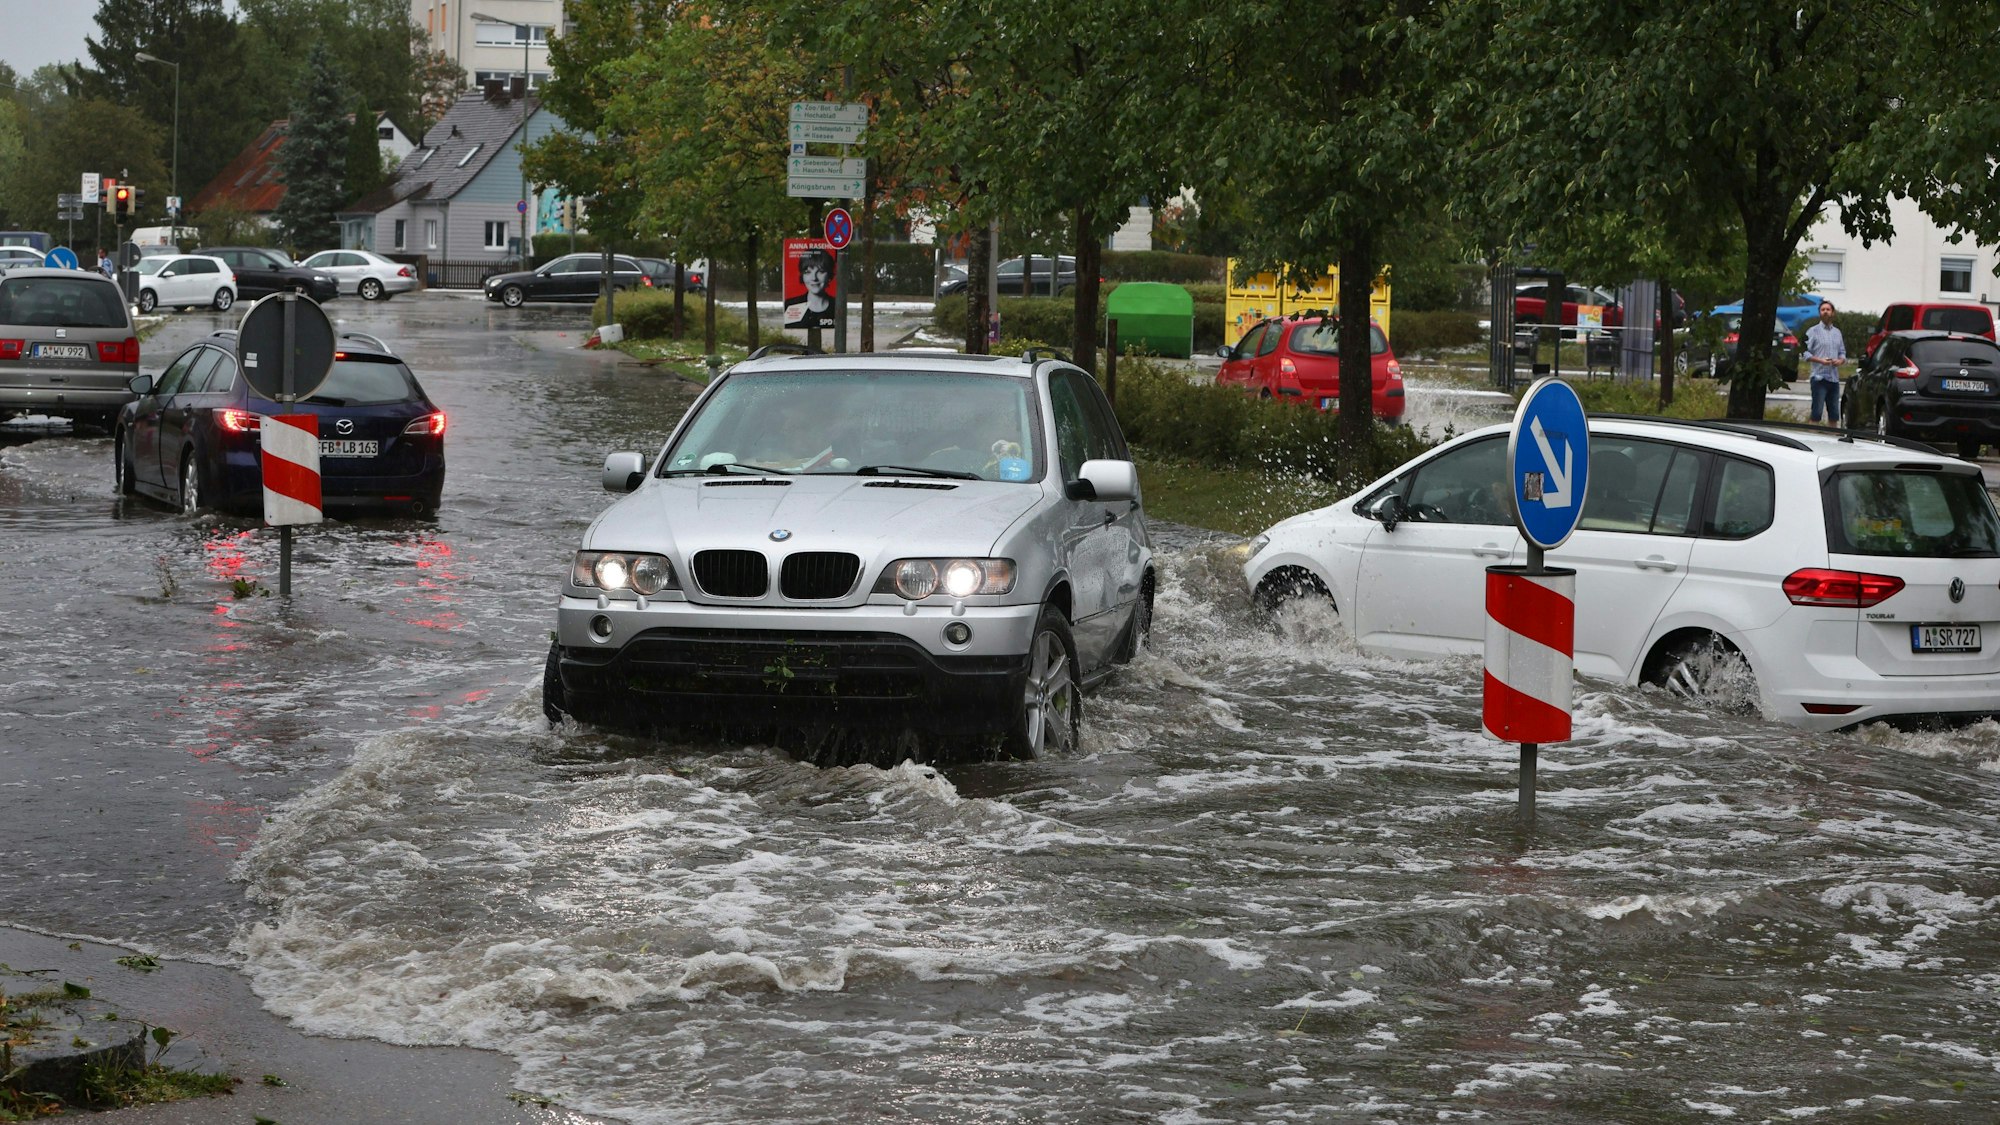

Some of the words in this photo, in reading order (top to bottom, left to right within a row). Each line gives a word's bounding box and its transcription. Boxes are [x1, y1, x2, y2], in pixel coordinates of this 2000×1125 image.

[791, 183, 836, 192] Königsbrunn
[43, 347, 48, 356] A
[53, 347, 65, 356] WV
[67, 347, 83, 357] 992
[343, 441, 356, 453] LB
[359, 442, 377, 454] 163
[1924, 629, 1932, 646] A
[1939, 629, 1954, 646] SR
[1955, 629, 1975, 646] 727
